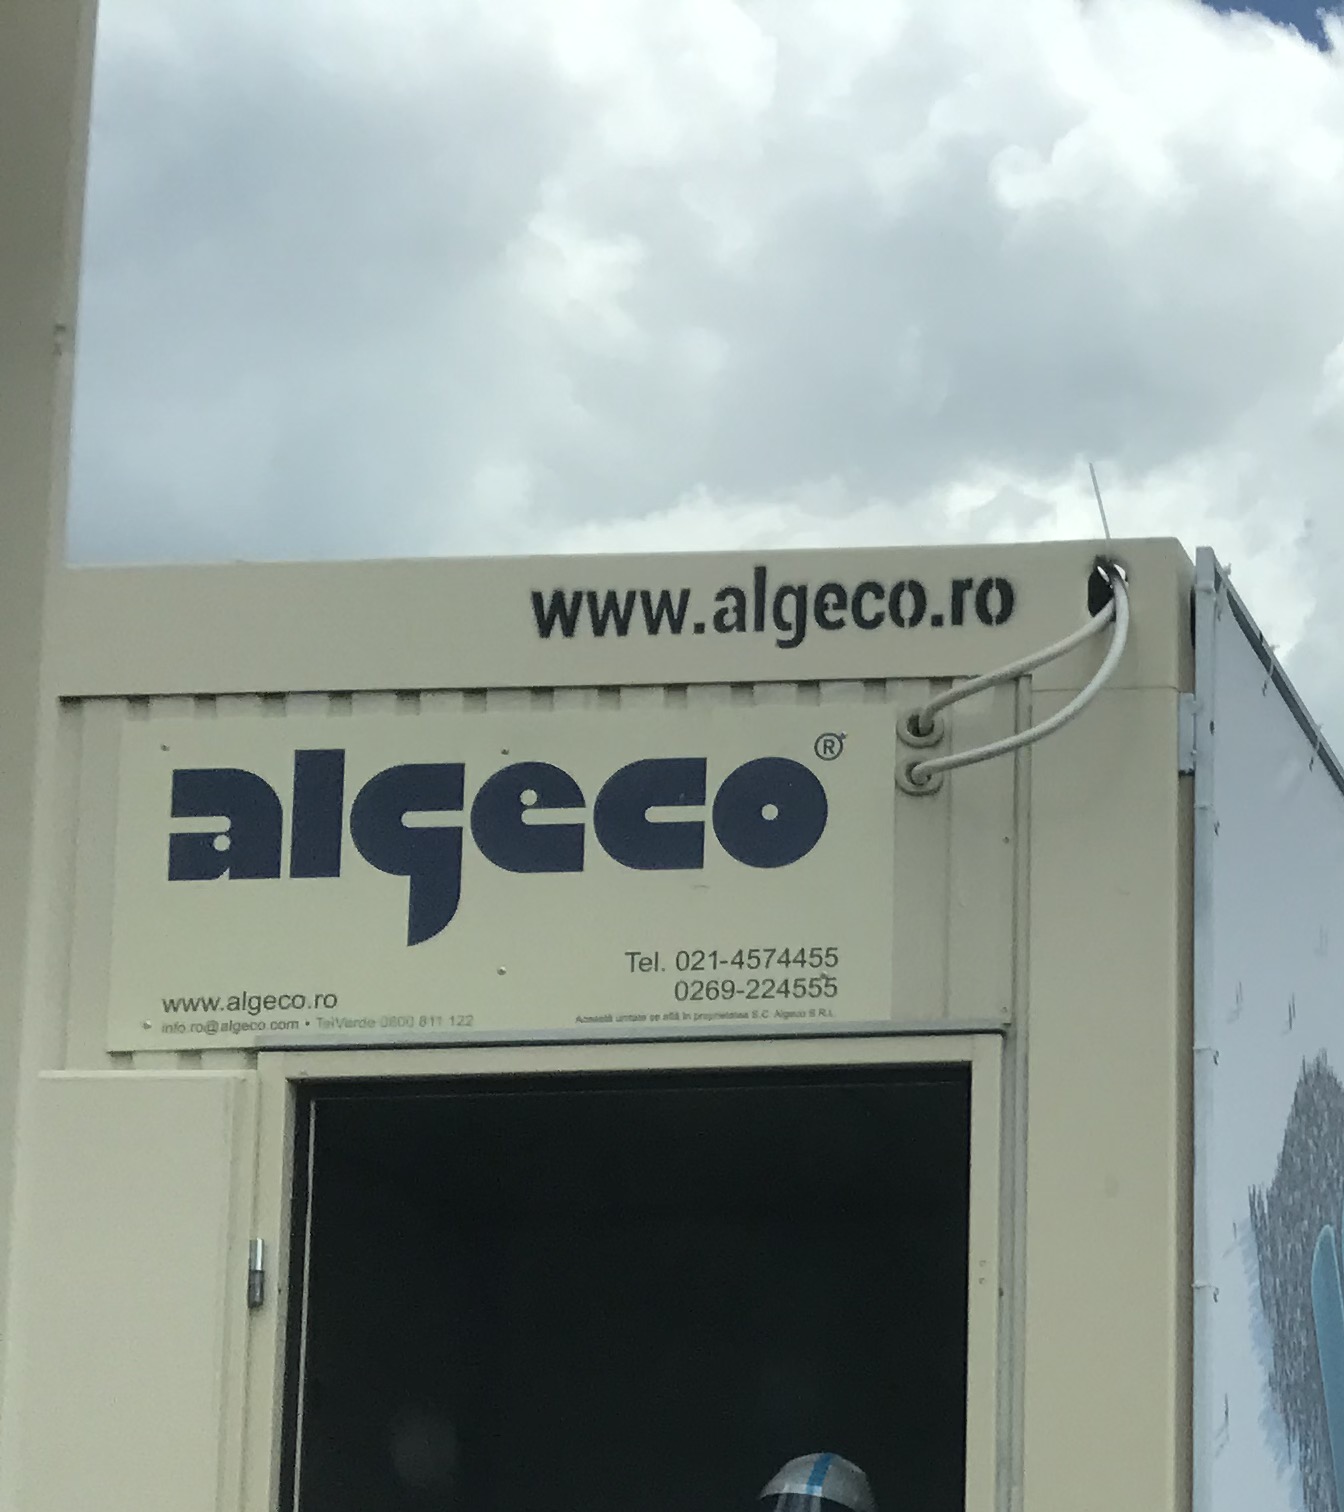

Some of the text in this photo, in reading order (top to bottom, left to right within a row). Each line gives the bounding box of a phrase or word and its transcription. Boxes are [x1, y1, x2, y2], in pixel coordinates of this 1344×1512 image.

[530, 566, 1016, 648] www.algeco.ro
[167, 748, 828, 947] algeco
[625, 947, 839, 973] Tel. 021-4574455
[674, 976, 839, 1001] 0269-224555
[161, 991, 338, 1015] www.algeco.ro
